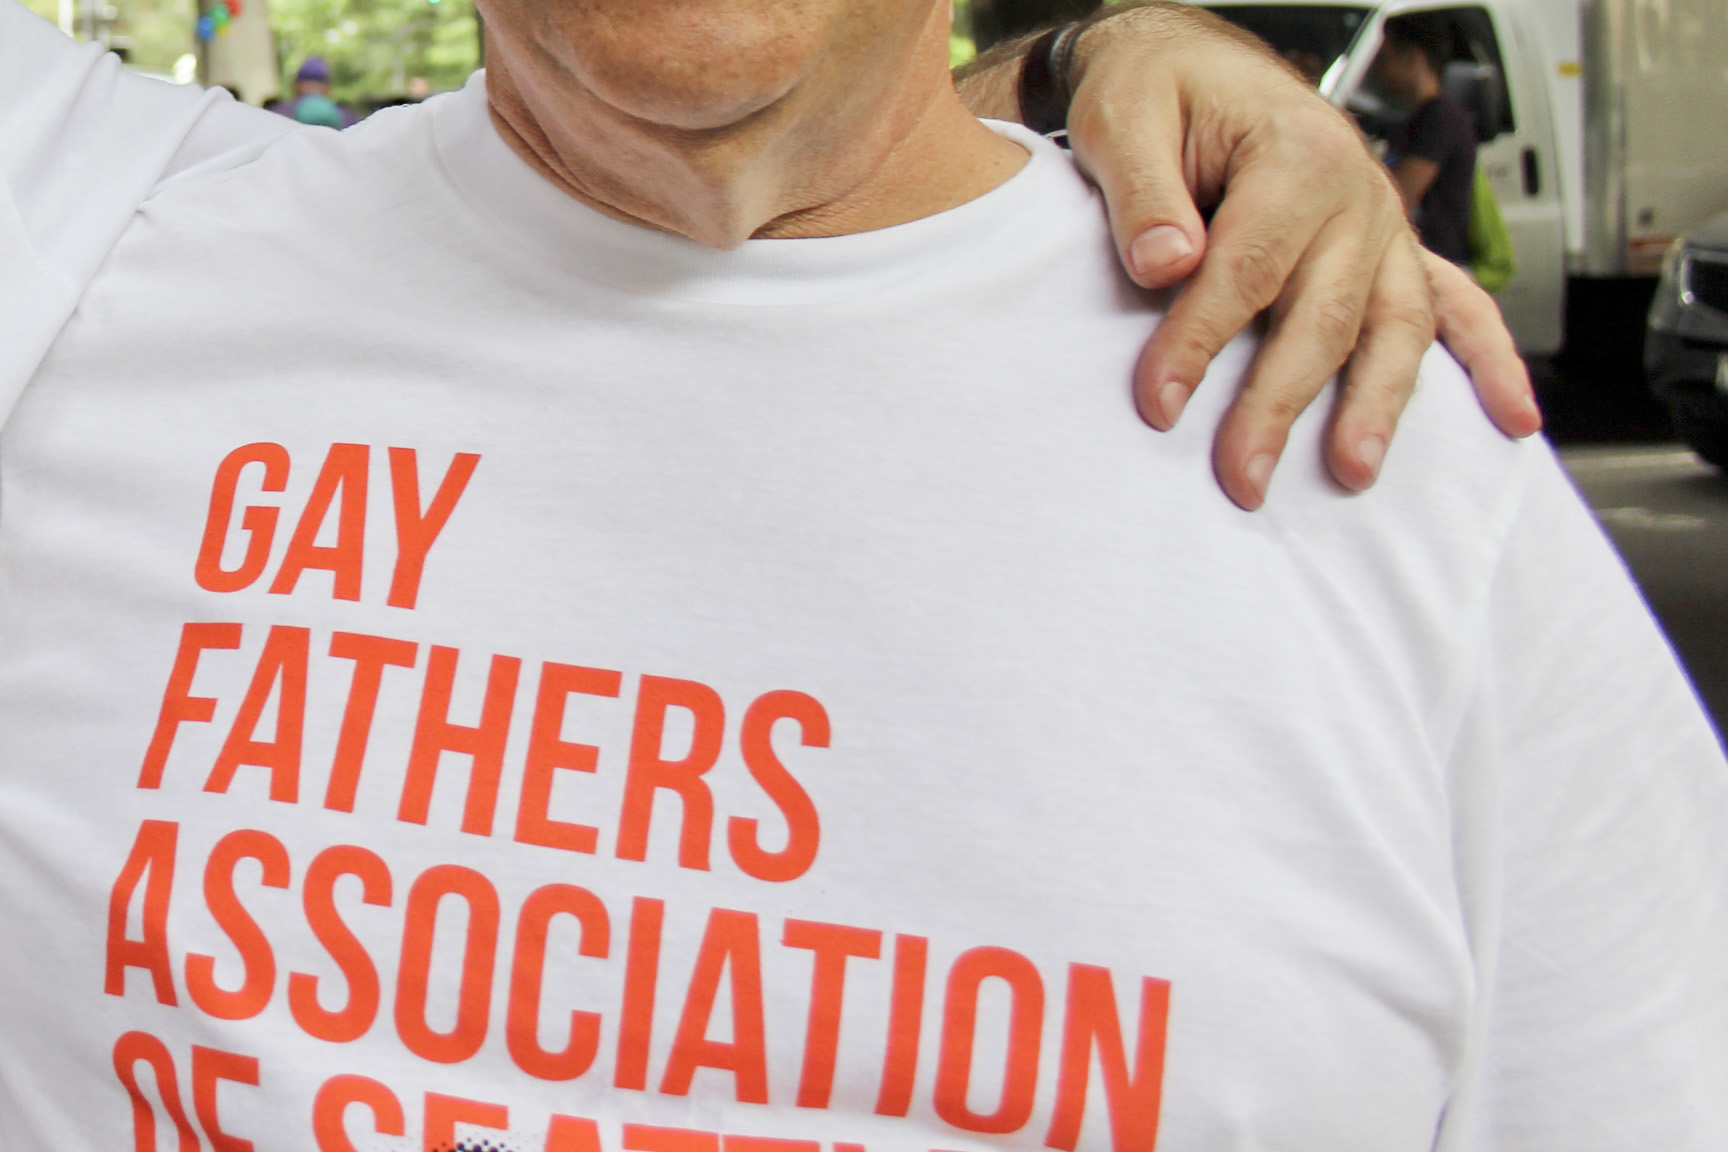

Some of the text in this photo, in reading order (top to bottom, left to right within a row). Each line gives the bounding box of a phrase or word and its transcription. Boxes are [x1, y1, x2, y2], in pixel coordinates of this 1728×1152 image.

[194, 441, 482, 609] GAY
[137, 622, 832, 882] FATHERS
[104, 819, 1172, 1152] ASSOCIATION
